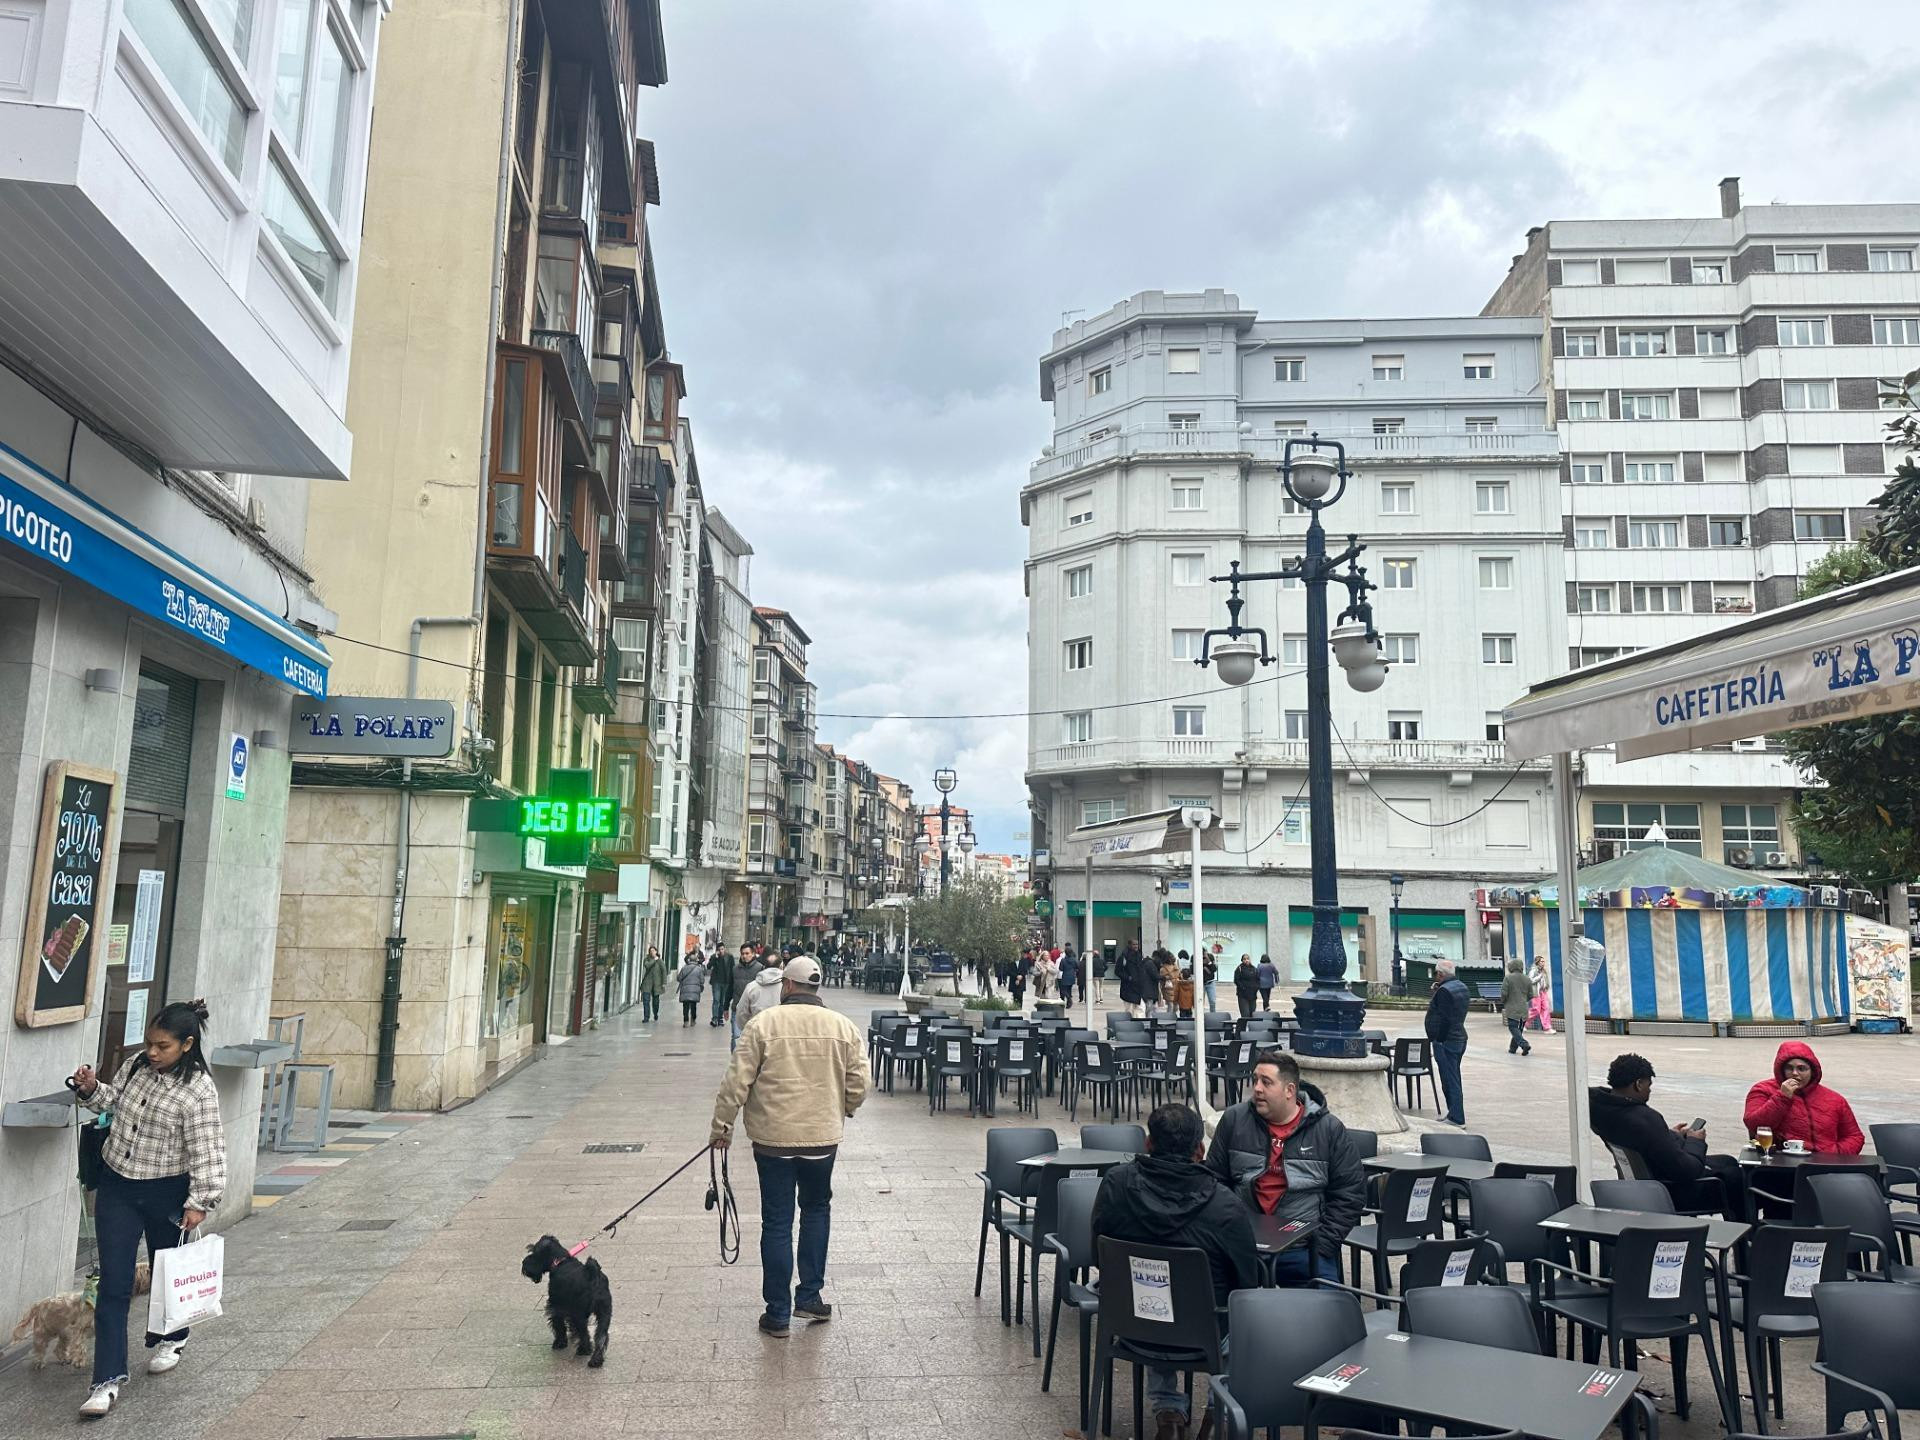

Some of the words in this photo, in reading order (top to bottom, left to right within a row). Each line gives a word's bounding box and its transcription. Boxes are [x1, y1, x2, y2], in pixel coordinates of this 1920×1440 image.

[283, 655, 324, 697] CAFETERÍA
[1656, 665, 1786, 726] CAFETERÍA
[1812, 638, 1880, 691] "LA
[300, 712, 344, 738] "LA
[353, 713, 446, 739] POLAR"
[76, 784, 92, 811] La
[576, 802, 611, 833] DE
[52, 870, 93, 906] Casa
